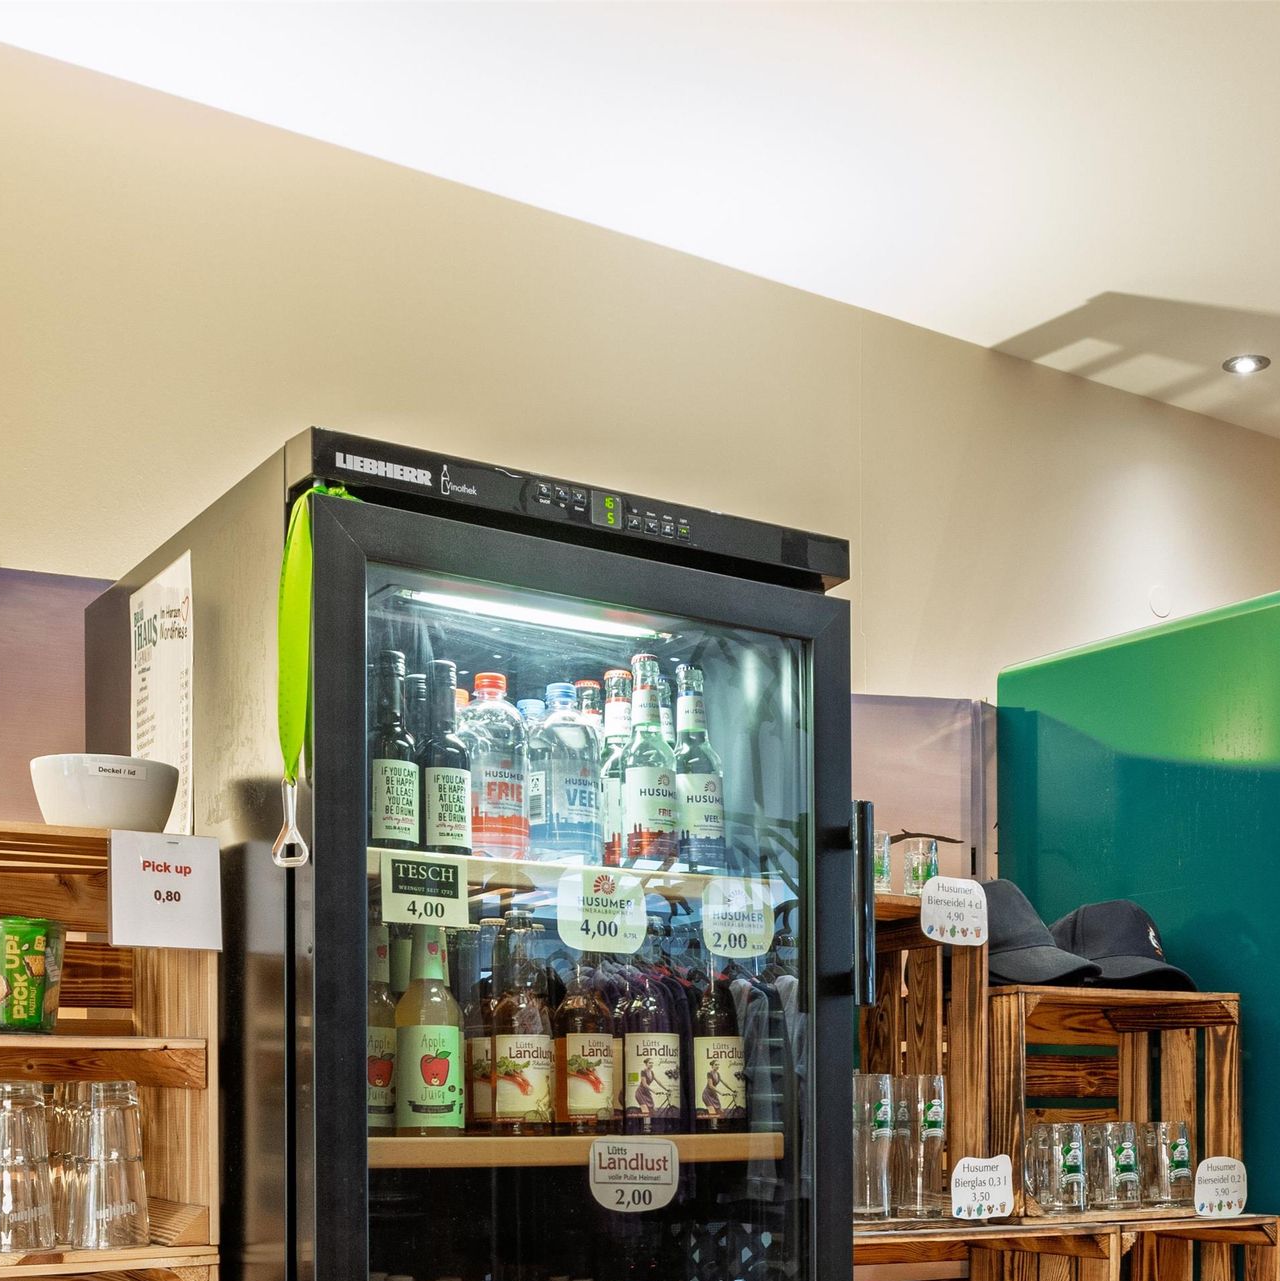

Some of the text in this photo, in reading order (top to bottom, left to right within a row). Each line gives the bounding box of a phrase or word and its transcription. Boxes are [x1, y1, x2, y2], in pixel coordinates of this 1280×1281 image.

[335, 451, 478, 496] LIEBHERR Vinothek
[137, 614, 158, 651] HAUS
[98, 765, 122, 775] Deckel
[381, 766, 389, 775] IF
[390, 767, 402, 776] YOU
[386, 776, 395, 785] BE
[434, 774, 453, 783] IF YOU
[386, 786, 414, 797] AT LEAST
[438, 784, 447, 793] BE
[388, 796, 413, 806] YOU CAN
[438, 794, 447, 803] AT
[385, 805, 394, 814] BE
[441, 804, 465, 813] YOU CAN
[658, 808, 672, 817] FRIE
[438, 812, 447, 822] BE
[142, 860, 193, 877] Pick up
[395, 863, 454, 882] TESCH
[937, 883, 972, 894] Husumer
[154, 889, 181, 903] 0,80
[927, 896, 982, 909] Bierseidel 4 cl
[407, 900, 445, 919] 4,00
[947, 912, 964, 922] 4,90
[580, 919, 618, 939] 4,00
[712, 932, 747, 950] 2,00
[6, 935, 21, 969] UP!
[421, 1033, 446, 1051] Apple
[515, 1041, 534, 1049] Lütts
[588, 1040, 605, 1048] Lütts
[421, 1087, 445, 1104] Juicy
[607, 1146, 627, 1155] Lütts
[598, 1152, 669, 1171] Landlust
[962, 1163, 999, 1172] Husumer
[1207, 1163, 1236, 1171] Husumer
[955, 1177, 986, 1190] Bierglas
[988, 1177, 1001, 1187] 0,3
[1198, 1174, 1229, 1184] Bierseidel
[615, 1188, 652, 1209] 2,00
[972, 1192, 990, 1203] 3,50
